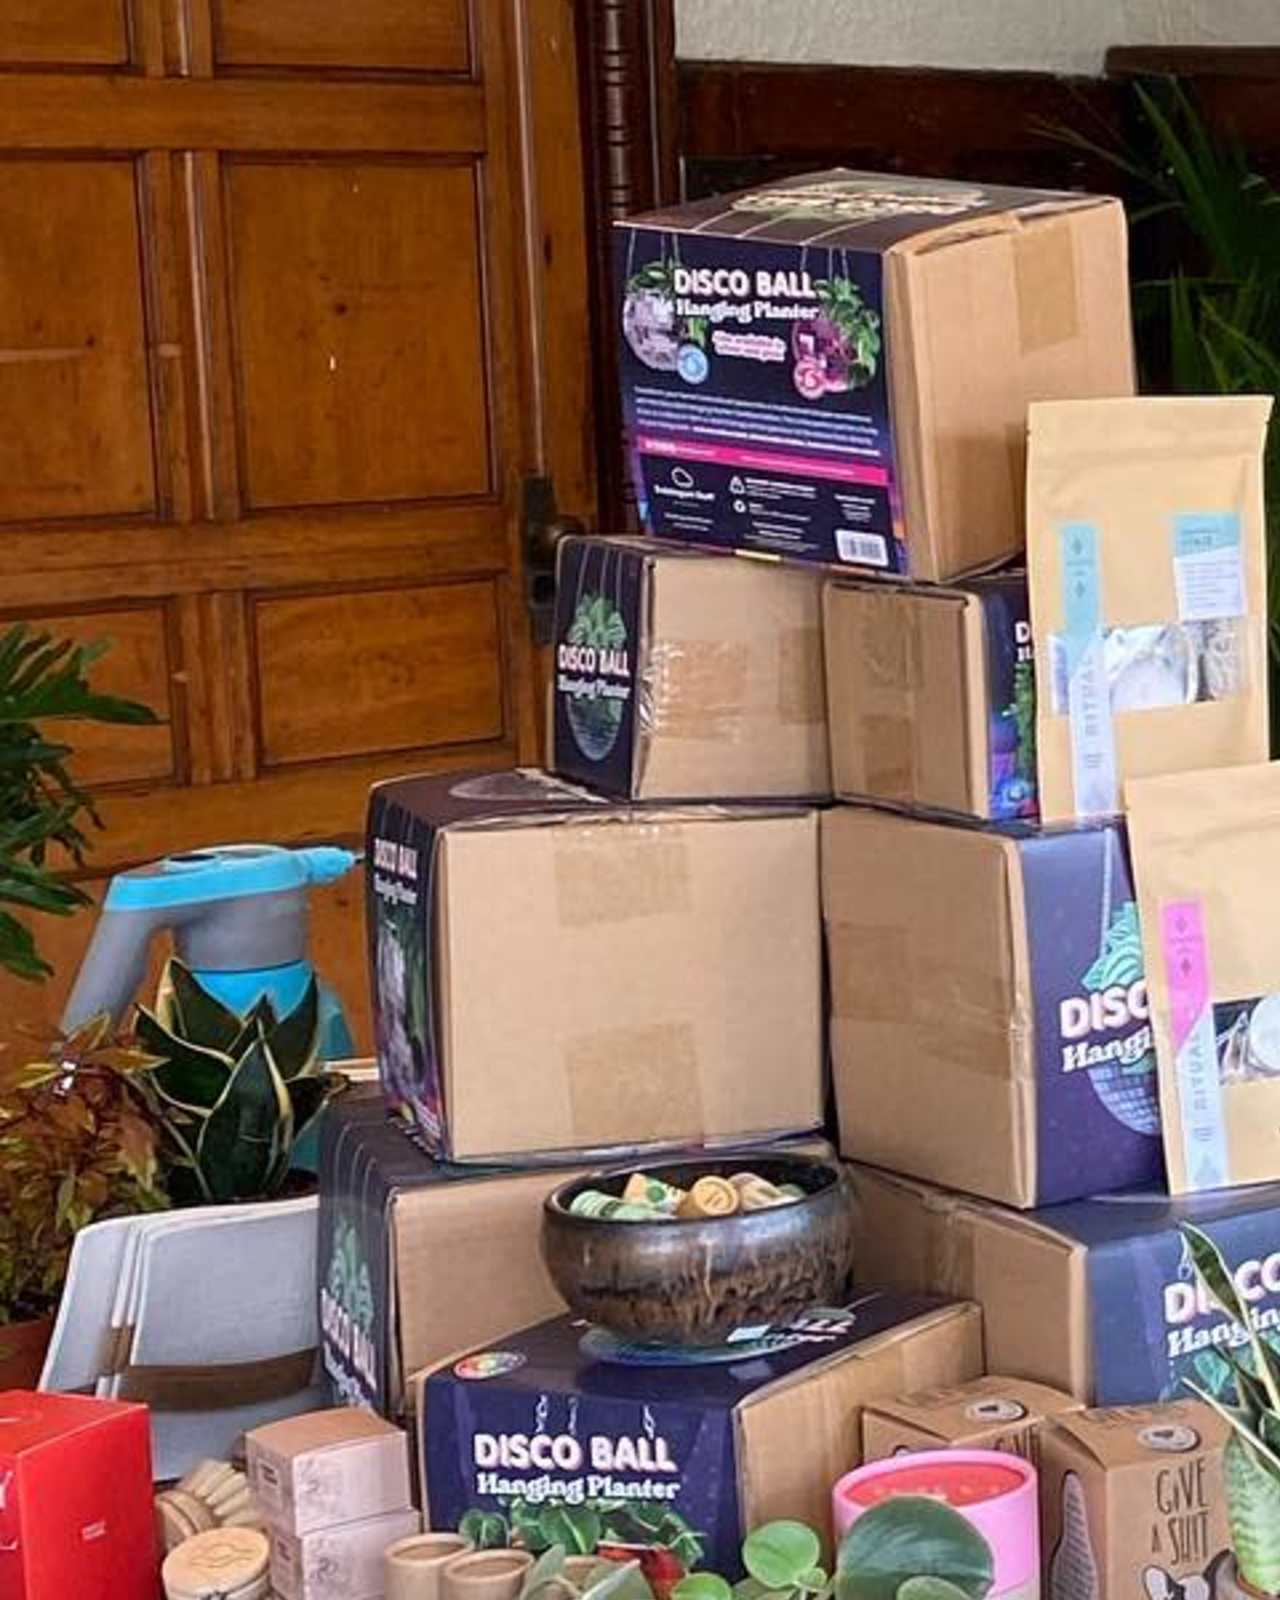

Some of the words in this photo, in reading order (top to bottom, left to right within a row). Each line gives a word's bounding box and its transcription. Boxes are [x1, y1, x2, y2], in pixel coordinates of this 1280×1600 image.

[674, 269, 750, 297] DISCO
[756, 271, 817, 299] BALL
[675, 299, 752, 323] Hanging
[754, 301, 819, 320] Planter
[558, 643, 595, 673] DISCO
[600, 650, 631, 677] BALL
[1060, 979, 1149, 1039] DISC
[473, 1433, 583, 1471] DISCO
[591, 1436, 678, 1473] BALL
[477, 1473, 586, 1502] Hanging
[587, 1475, 681, 1500] Planter
[1156, 1457, 1209, 1515] GIVE
